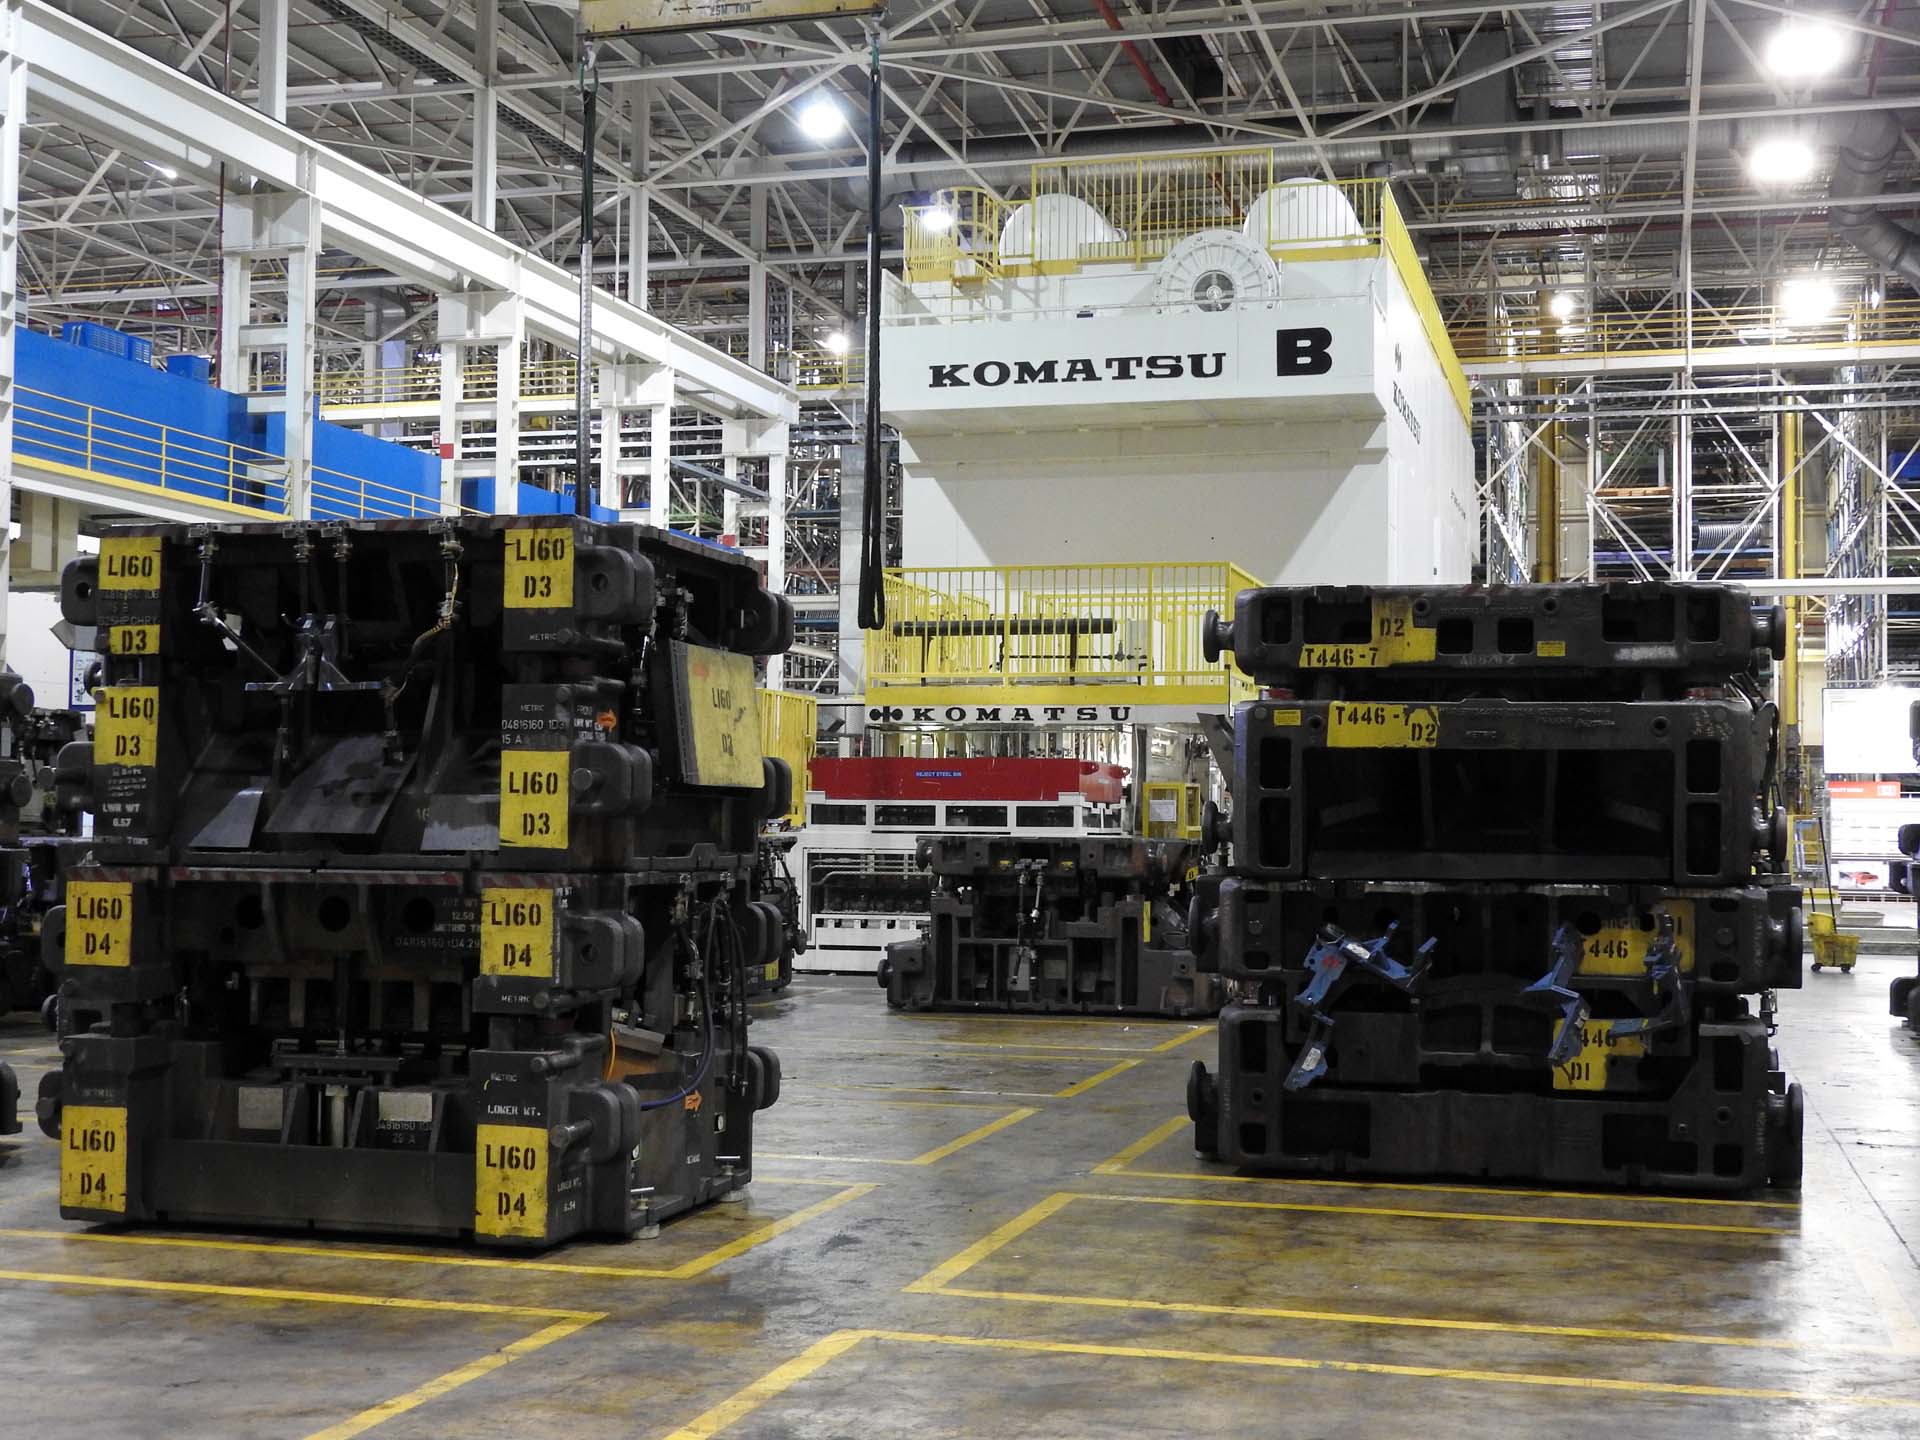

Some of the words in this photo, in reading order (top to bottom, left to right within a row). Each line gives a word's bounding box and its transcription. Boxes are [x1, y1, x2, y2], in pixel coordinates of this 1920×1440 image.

[1276, 326, 1332, 377] B
[929, 352, 1226, 388] KOMATSU
[524, 575, 552, 598] D3
[1380, 618, 1405, 637] D2
[121, 630, 148, 652] D3
[912, 707, 1131, 722] KOMATSU
[1411, 723, 1436, 742] D2
[115, 735, 141, 757] D3
[125, 803, 140, 813] WT
[523, 812, 551, 836] D3
[85, 932, 111, 955] D4
[1583, 939, 1629, 959] 446
[503, 943, 532, 967] D4
[487, 1104, 518, 1116] LOWER
[80, 1173, 106, 1195] D4
[498, 1192, 527, 1217] D4
